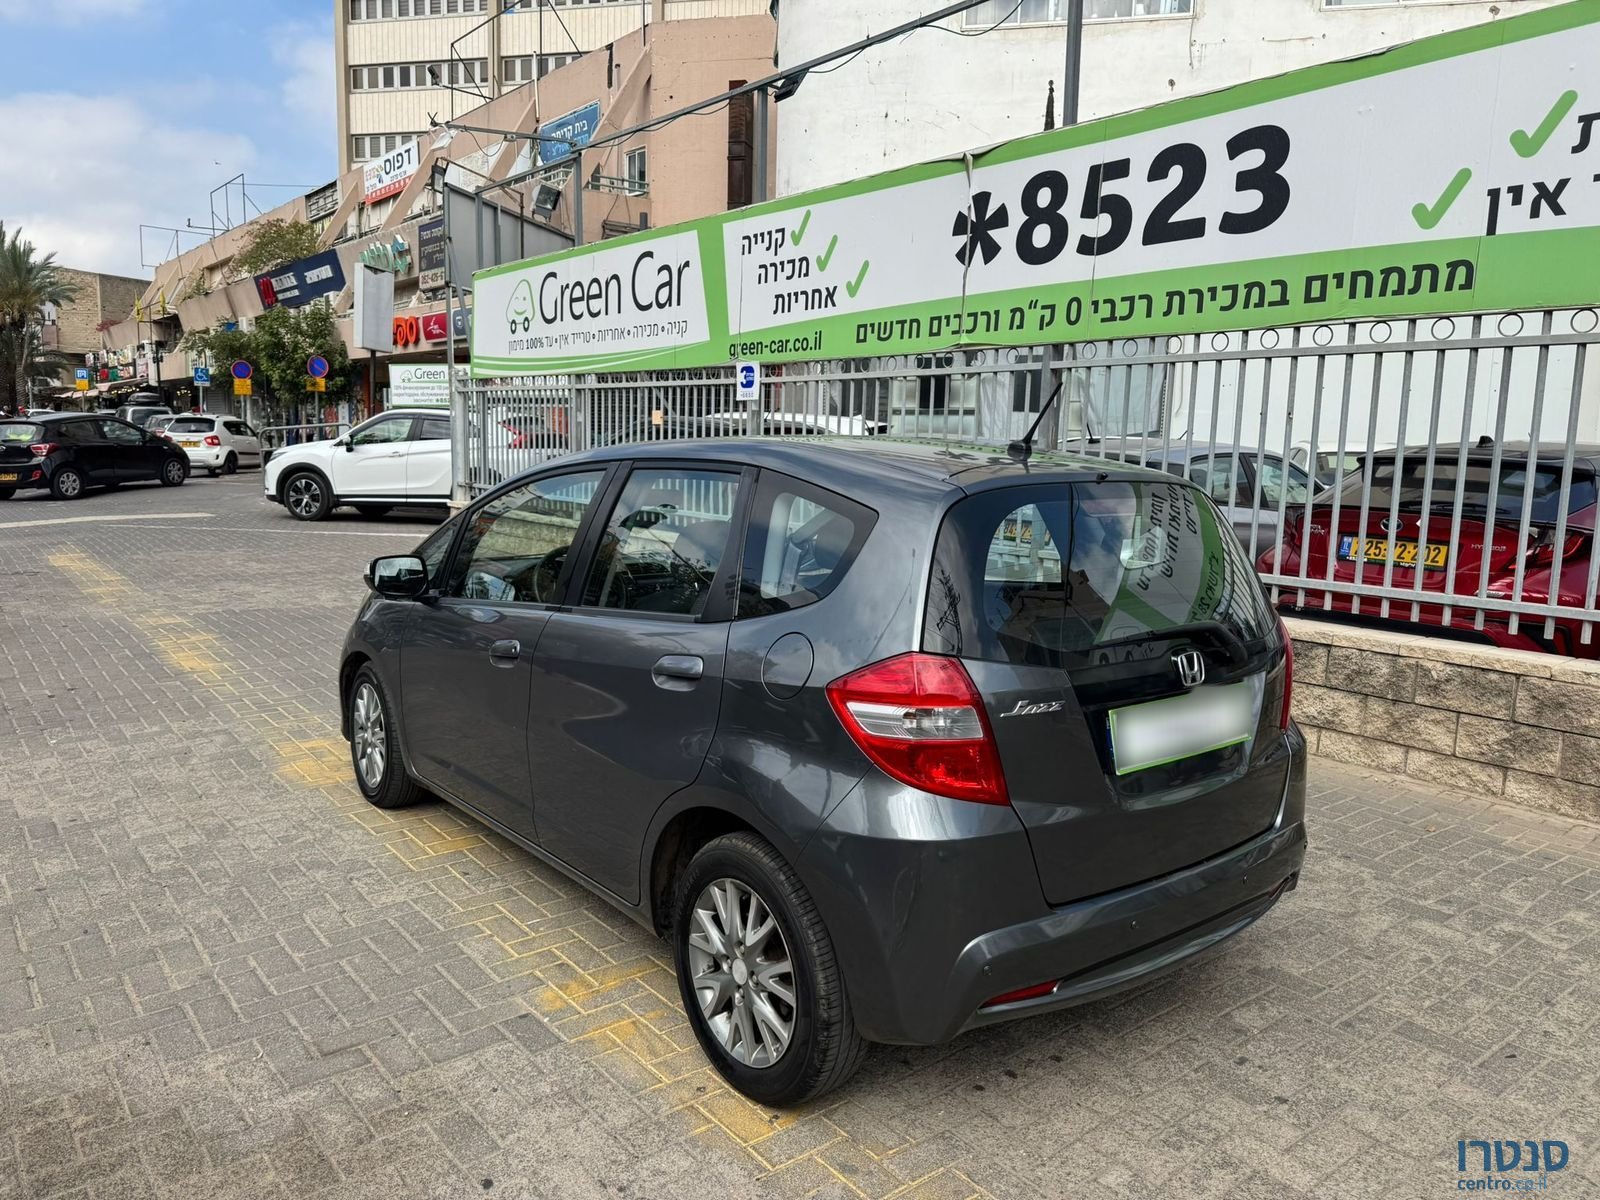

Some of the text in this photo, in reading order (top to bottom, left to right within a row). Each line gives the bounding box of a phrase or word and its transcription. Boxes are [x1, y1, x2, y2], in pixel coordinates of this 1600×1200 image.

[574, 120, 588, 134] בית
[383, 147, 411, 175] דפוס
[1486, 177, 1572, 236] אין
[741, 227, 786, 257] קנייה
[758, 256, 810, 284] מכירה
[1303, 259, 1474, 304] מתמחים
[539, 250, 690, 325] Green Car
[773, 286, 838, 315] אחריות
[1163, 279, 1290, 317] במכירת
[1065, 296, 1082, 326] 0
[1091, 293, 1153, 323] רכבי
[508, 320, 688, 355] קניה מכירה אחריות טרייד אין עד 100% מימון
[856, 317, 921, 343] חדשים
[928, 310, 1000, 337] ורכבים
[729, 330, 822, 359] green-car.co.il
[414, 367, 446, 380] Green
